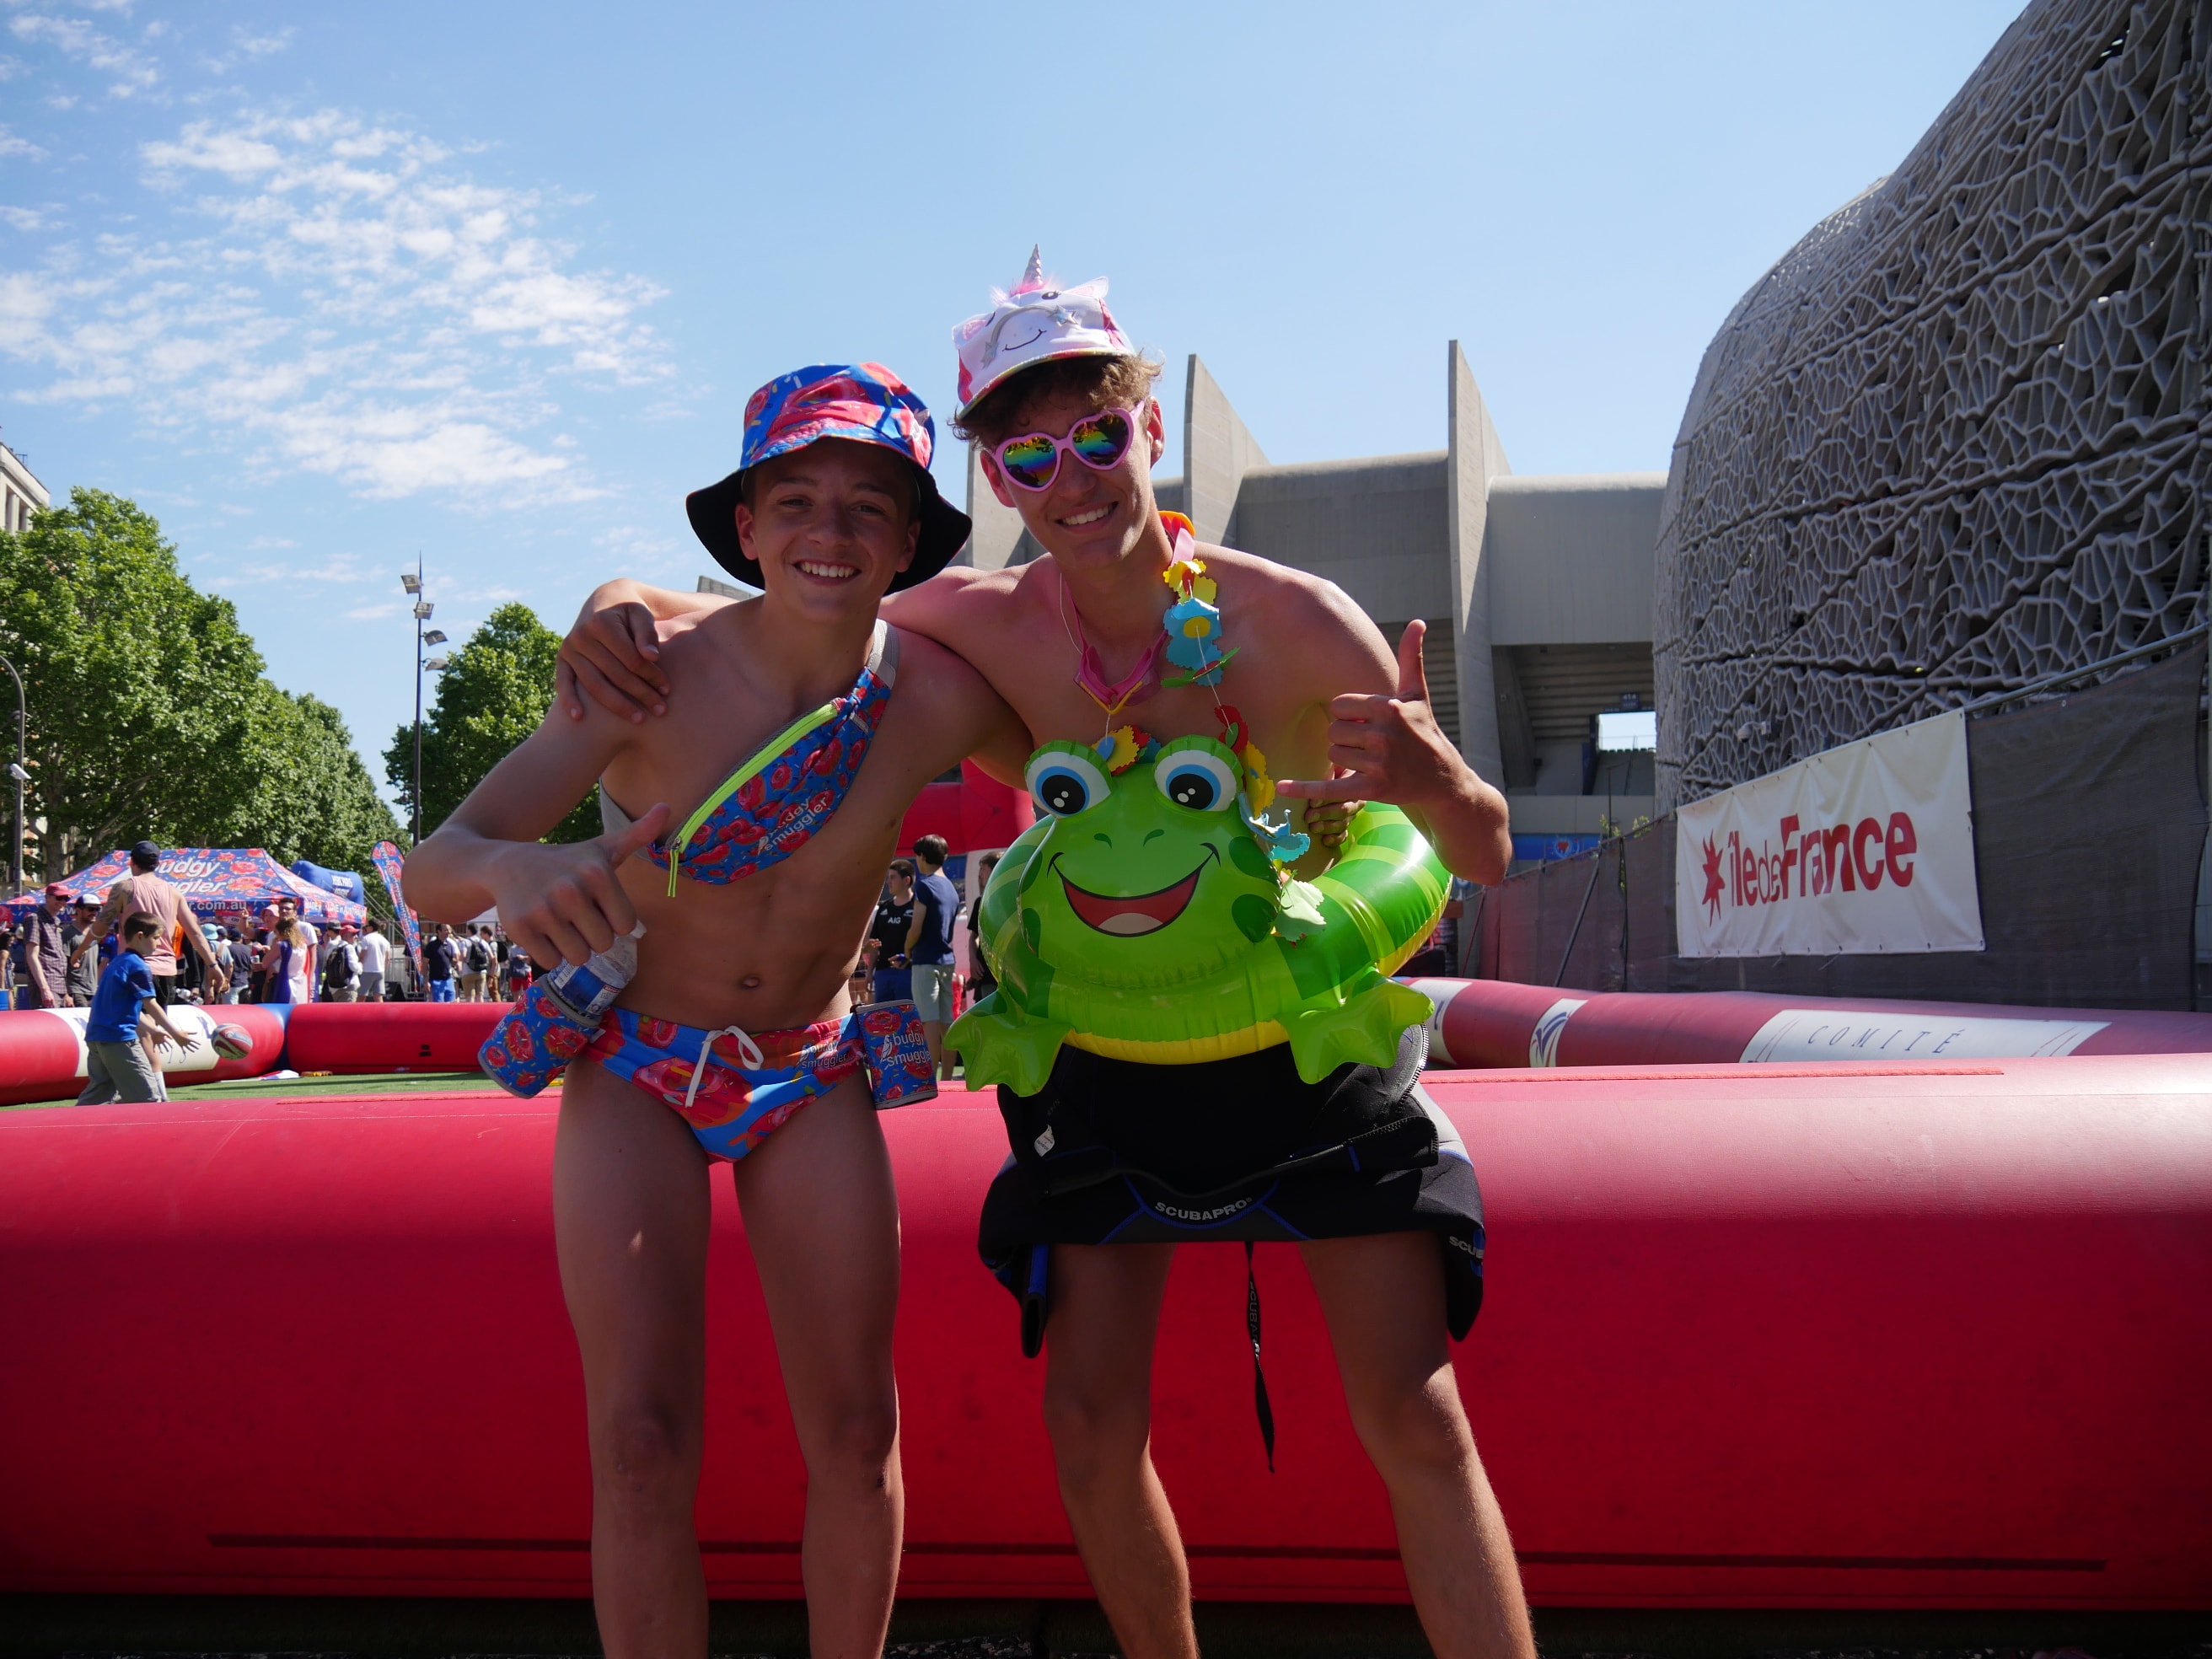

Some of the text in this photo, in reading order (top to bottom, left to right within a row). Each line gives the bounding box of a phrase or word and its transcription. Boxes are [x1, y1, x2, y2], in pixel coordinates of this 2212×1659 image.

[765, 797, 826, 851] smuggler
[155, 856, 221, 878] udgy
[893, 1030, 924, 1046] budgy
[1807, 1025, 1966, 1055] COMITÉ
[802, 1053, 847, 1069] smuggler
[1449, 1236, 1485, 1259] SCUB
